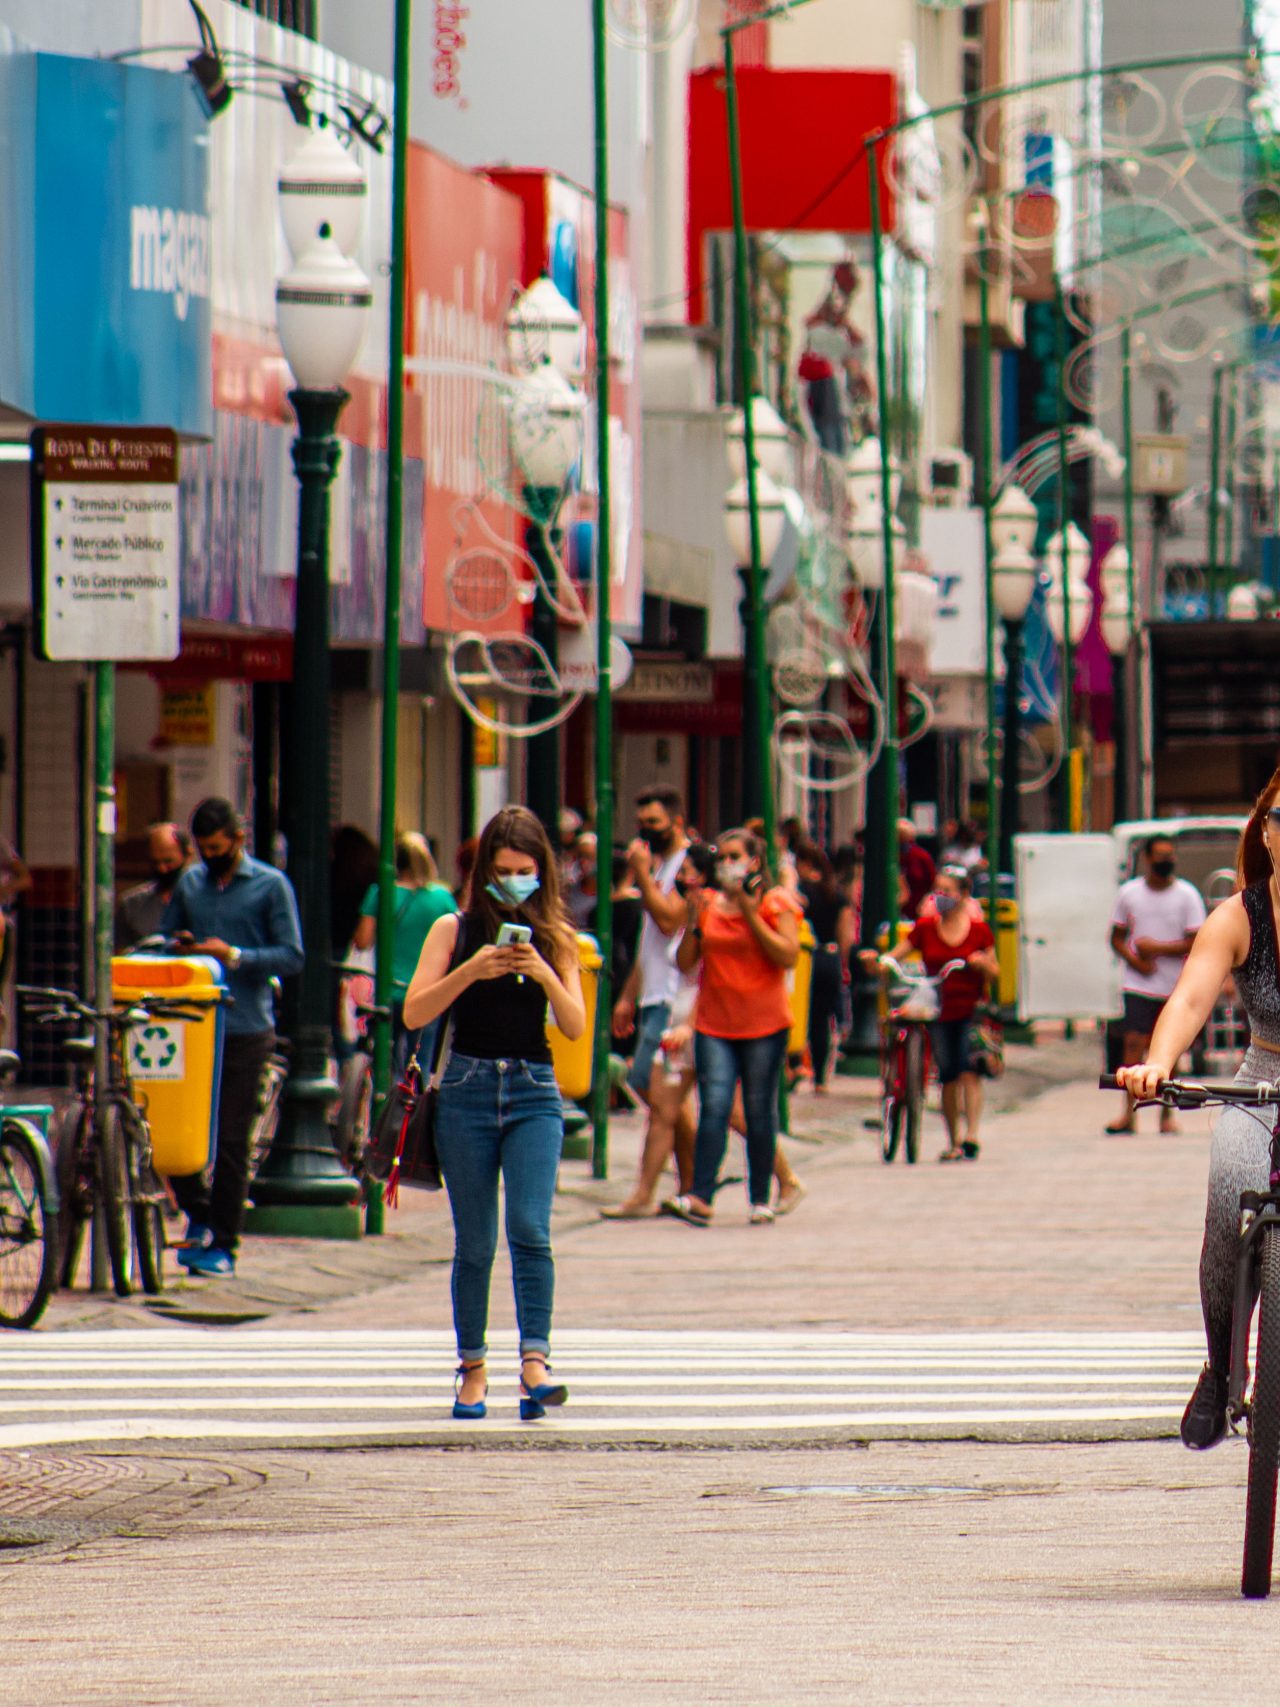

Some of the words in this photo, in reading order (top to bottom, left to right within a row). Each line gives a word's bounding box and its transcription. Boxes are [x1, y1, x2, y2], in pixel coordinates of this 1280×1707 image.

[72, 498, 120, 512] Terminal
[122, 498, 172, 512] Cruzeiros
[72, 536, 121, 550] Mercado
[123, 535, 164, 551] Público
[72, 575, 90, 588] Via
